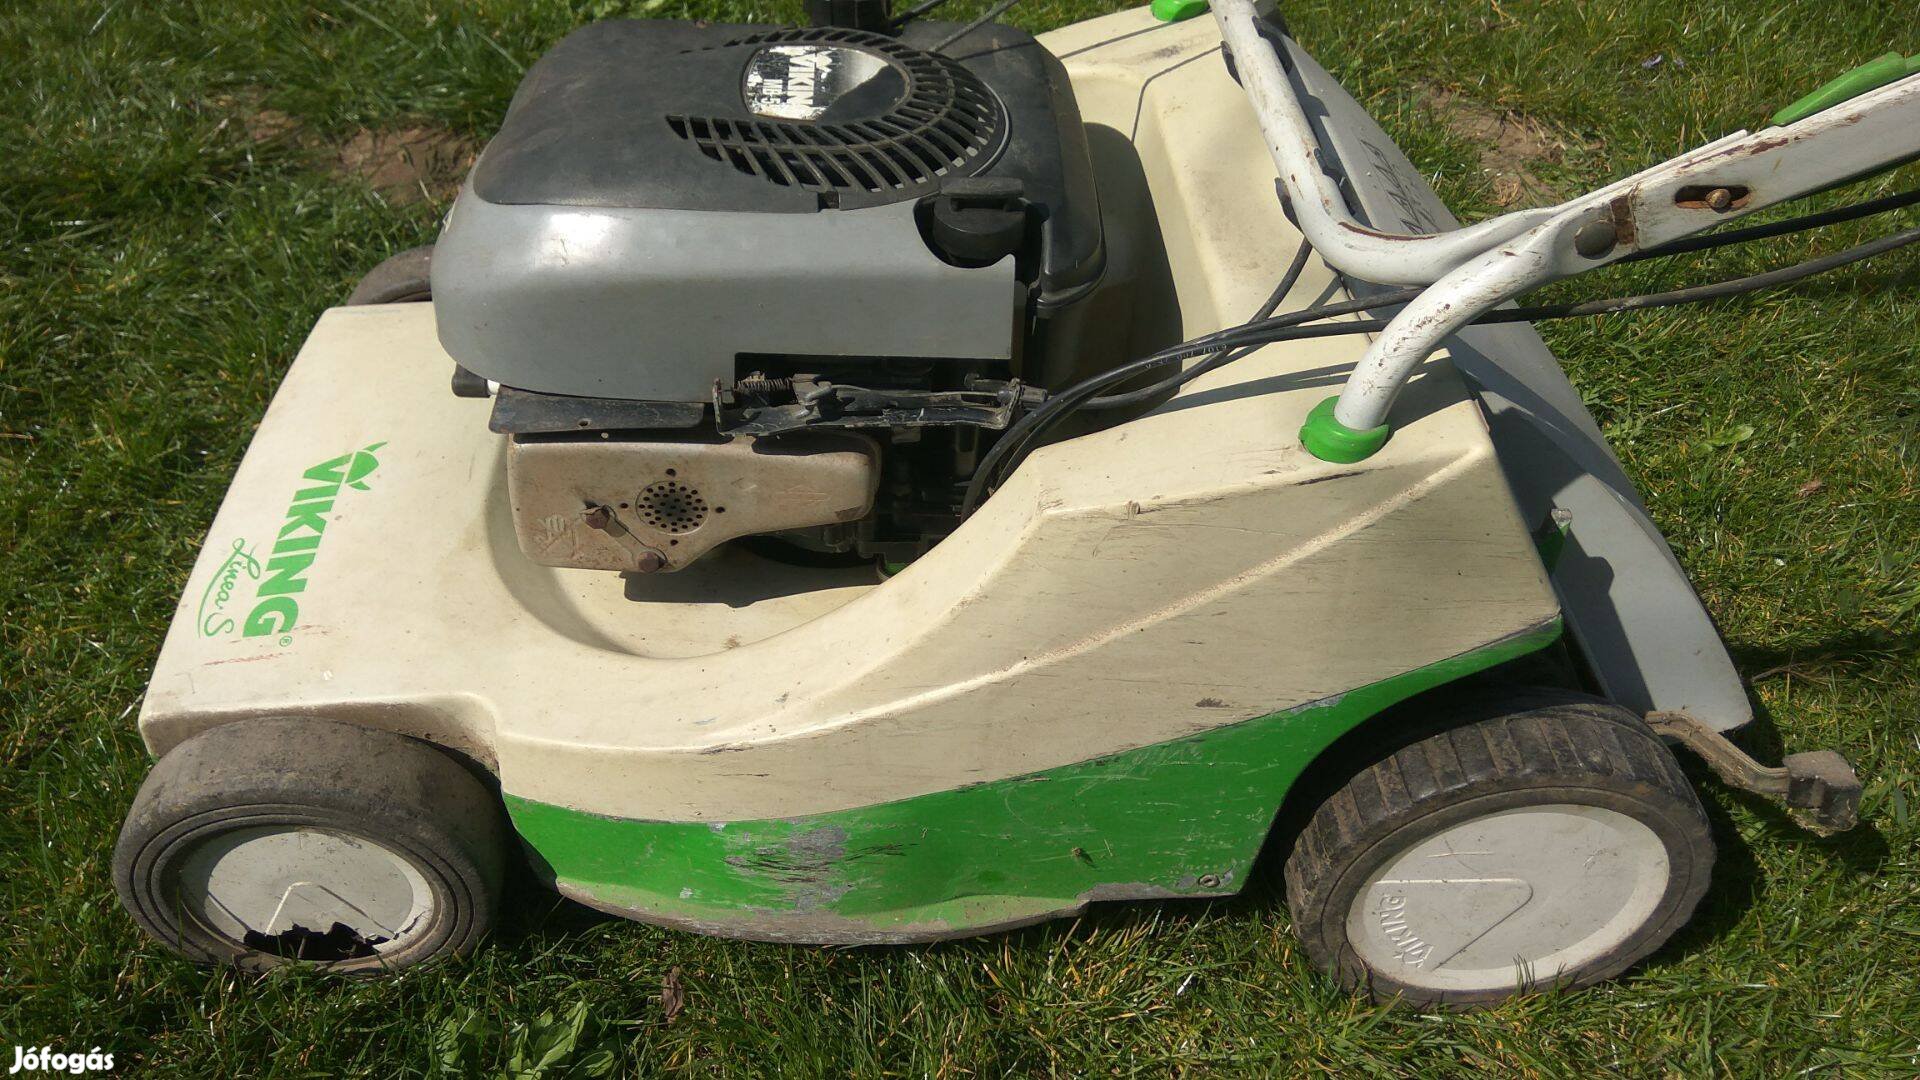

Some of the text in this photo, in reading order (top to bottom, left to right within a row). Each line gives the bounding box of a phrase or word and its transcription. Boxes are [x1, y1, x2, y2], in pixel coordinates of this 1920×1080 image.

[204, 538, 260, 637] Linea S
[1380, 894, 1433, 966] VIKING
